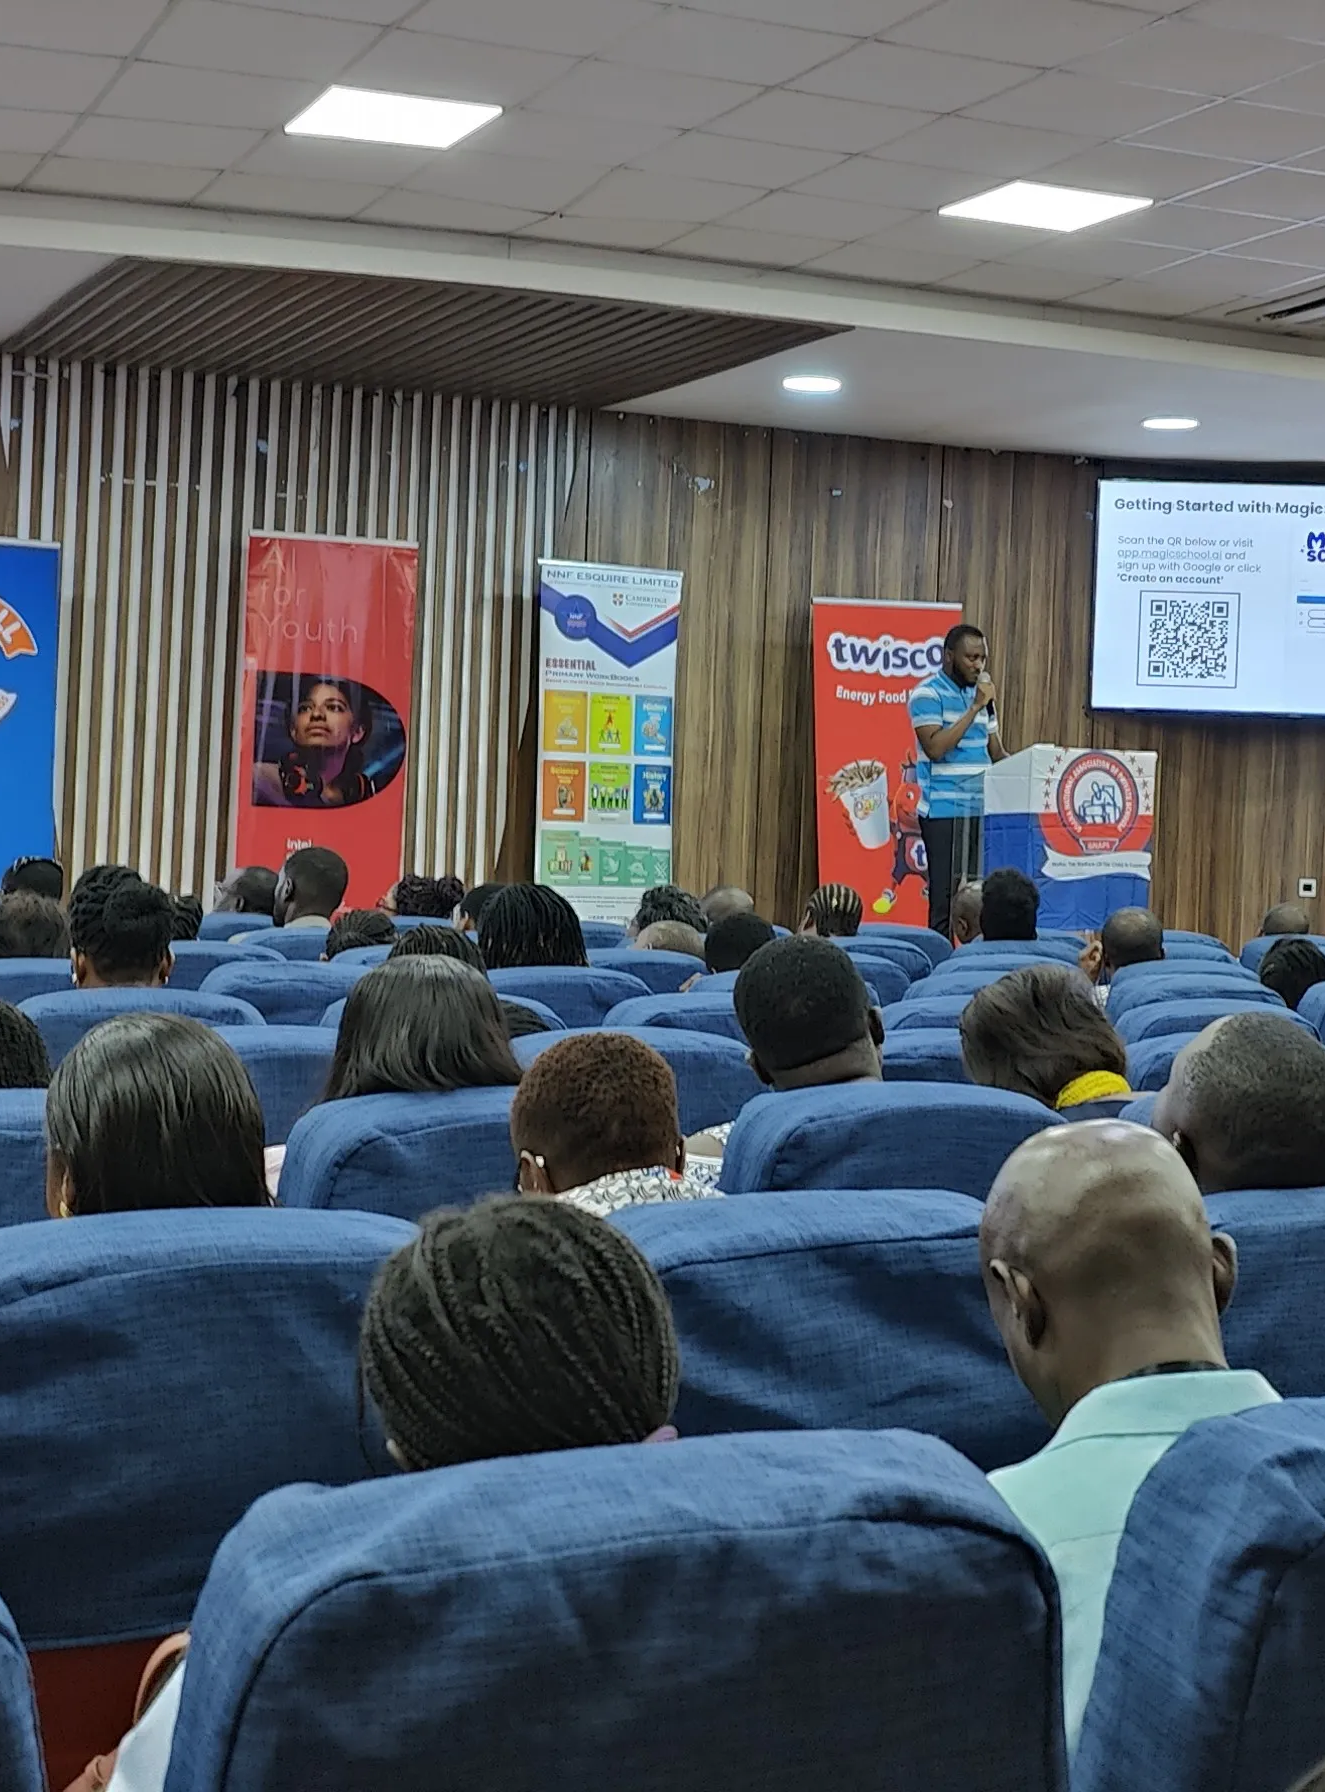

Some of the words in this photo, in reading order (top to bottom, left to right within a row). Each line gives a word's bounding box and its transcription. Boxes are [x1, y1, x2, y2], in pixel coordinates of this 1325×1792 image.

[1114, 498, 1172, 515] Getting
[1176, 499, 1234, 513] Started
[1238, 500, 1272, 514] with
[1118, 536, 1145, 546] Scan
[1148, 536, 1165, 546] the
[1167, 536, 1182, 547] QR
[1185, 536, 1216, 548] below
[1219, 539, 1230, 548] or
[1233, 538, 1254, 548] visit
[1117, 549, 1222, 561] app.magicschool.ai
[1224, 550, 1246, 560] and
[1117, 561, 1139, 573] sign
[1141, 563, 1156, 573] up
[1158, 562, 1181, 572] with
[1183, 562, 1221, 574] Google
[1223, 564, 1235, 572] or
[1237, 563, 1261, 573] click
[546, 570, 573, 579] NNF
[577, 572, 630, 584] ESQUIRE
[632, 577, 679, 588] LIMITED
[1158, 575, 1174, 584] an
[260, 580, 306, 606] for
[260, 612, 359, 643] Youth
[832, 638, 943, 671] twisco
[545, 657, 597, 671] ESSENTIAL
[836, 685, 876, 706] Energy
[878, 690, 907, 704] Food
